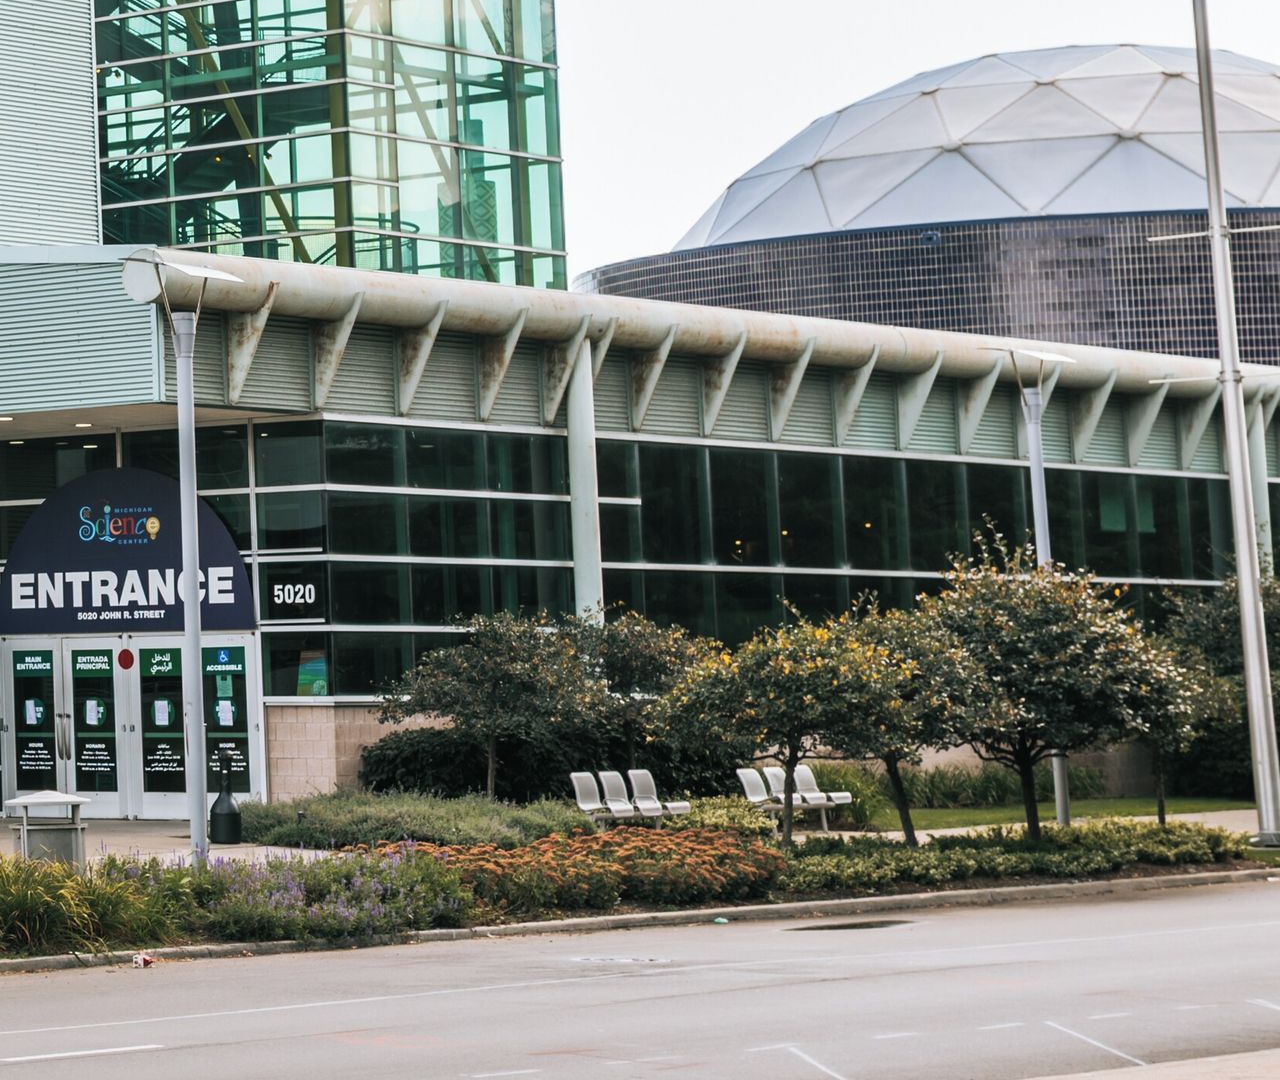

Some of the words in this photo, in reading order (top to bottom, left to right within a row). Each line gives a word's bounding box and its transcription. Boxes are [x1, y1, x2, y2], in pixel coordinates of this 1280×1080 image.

[79, 504, 161, 541] Science
[273, 583, 316, 605] 5020
[77, 612, 98, 620] 5020
[99, 611, 123, 620] JOHN
[124, 611, 133, 619] R.
[134, 610, 166, 619] STREET
